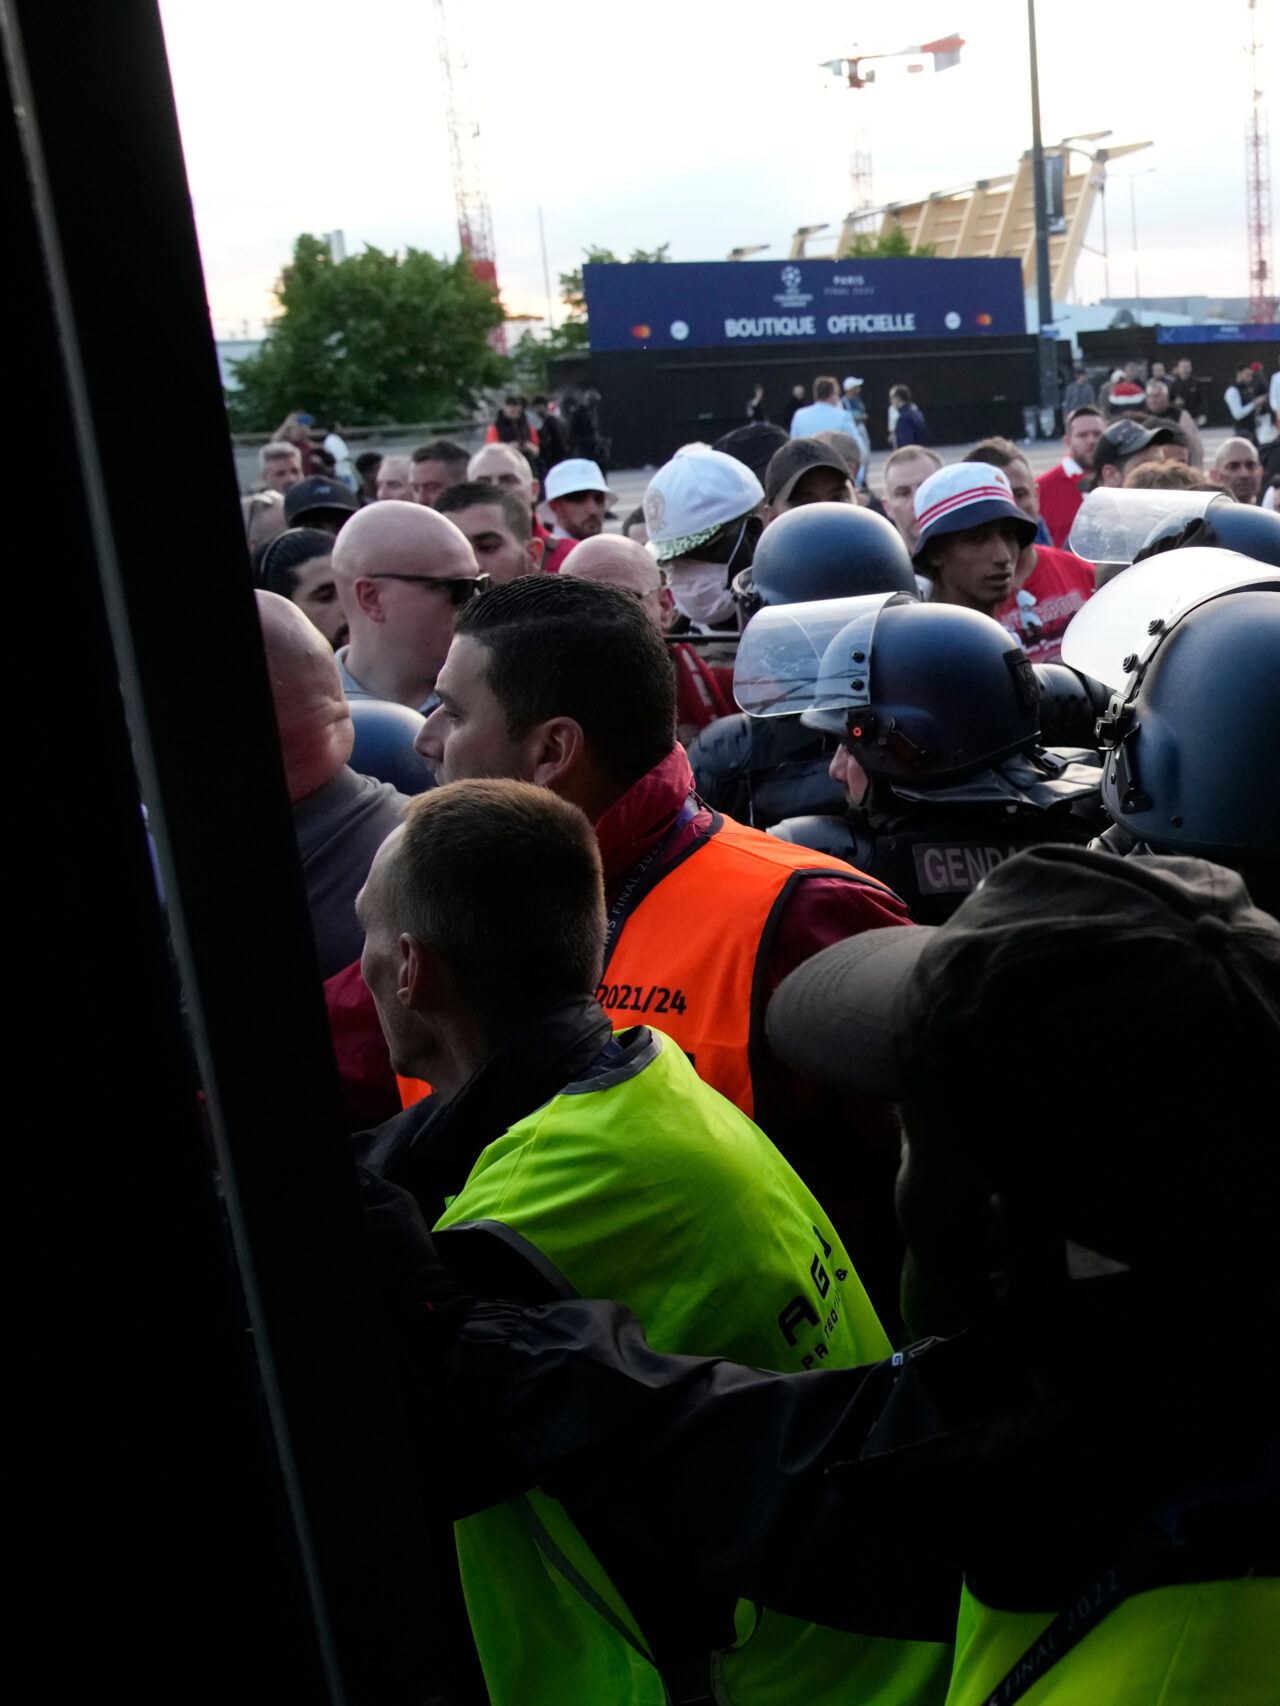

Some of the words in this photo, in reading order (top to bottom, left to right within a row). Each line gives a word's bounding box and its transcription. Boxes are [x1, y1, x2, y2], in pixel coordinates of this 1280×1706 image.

[832, 275, 865, 286] PARIS
[723, 316, 817, 338] BOUTIQUE
[826, 313, 917, 335] OFFICIELLE
[923, 845, 1019, 889] GEND
[595, 983, 688, 1016] 2021/24
